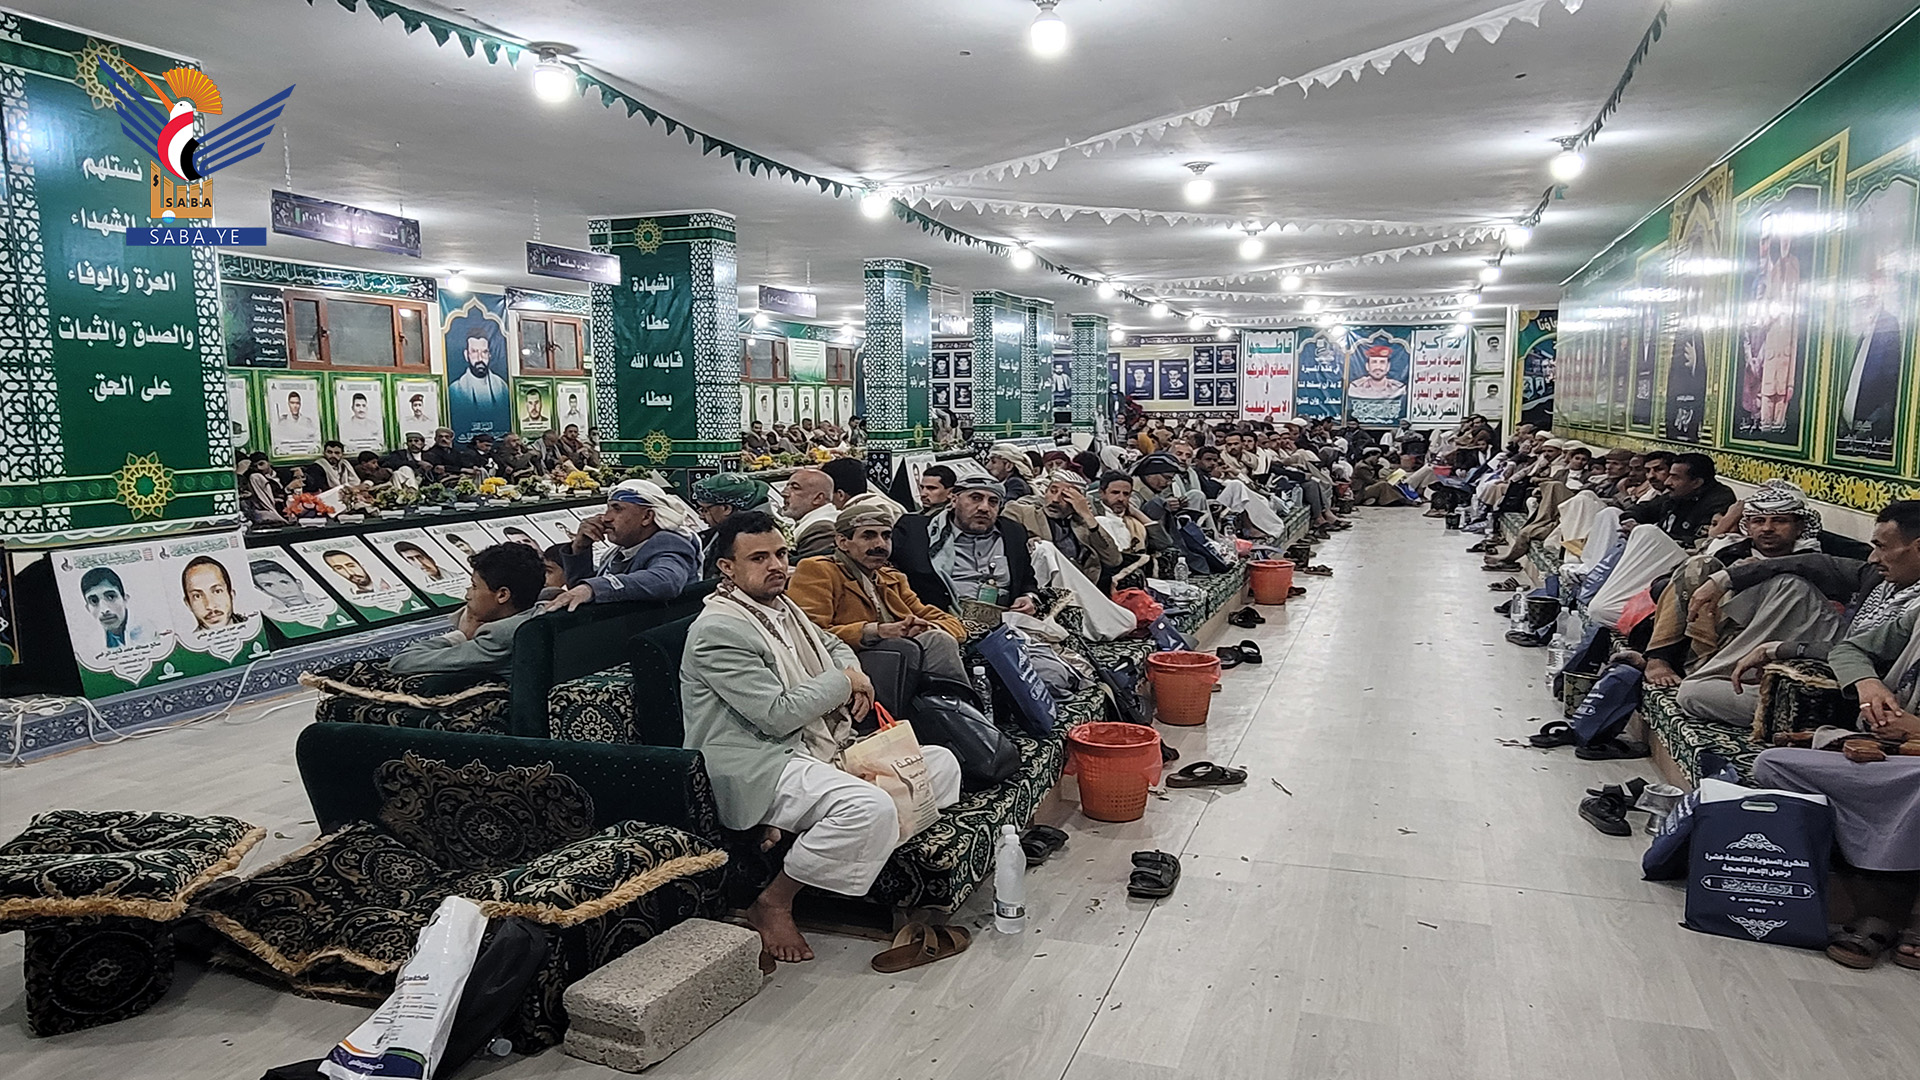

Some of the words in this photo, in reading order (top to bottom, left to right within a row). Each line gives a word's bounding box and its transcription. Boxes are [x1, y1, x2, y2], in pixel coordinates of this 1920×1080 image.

[83, 154, 143, 182] نستلهم
[71, 207, 137, 237] الشهداء
[67, 259, 130, 294] والوفاء
[134, 265, 177, 296] العزة
[632, 272, 674, 294] الشهادة
[58, 313, 127, 347] والثبات
[132, 320, 194, 350] والصدق
[630, 352, 648, 369] الله
[653, 350, 684, 374] قابله
[88, 372, 134, 402] الحق.
[140, 374, 172, 402] على
[640, 389, 673, 412] بعطاء
[1704, 852, 1725, 861] عشرة
[1721, 863, 1747, 873] الحجة
[1753, 856, 1783, 866] السنوية
[1783, 859, 1810, 868] الذكرى
